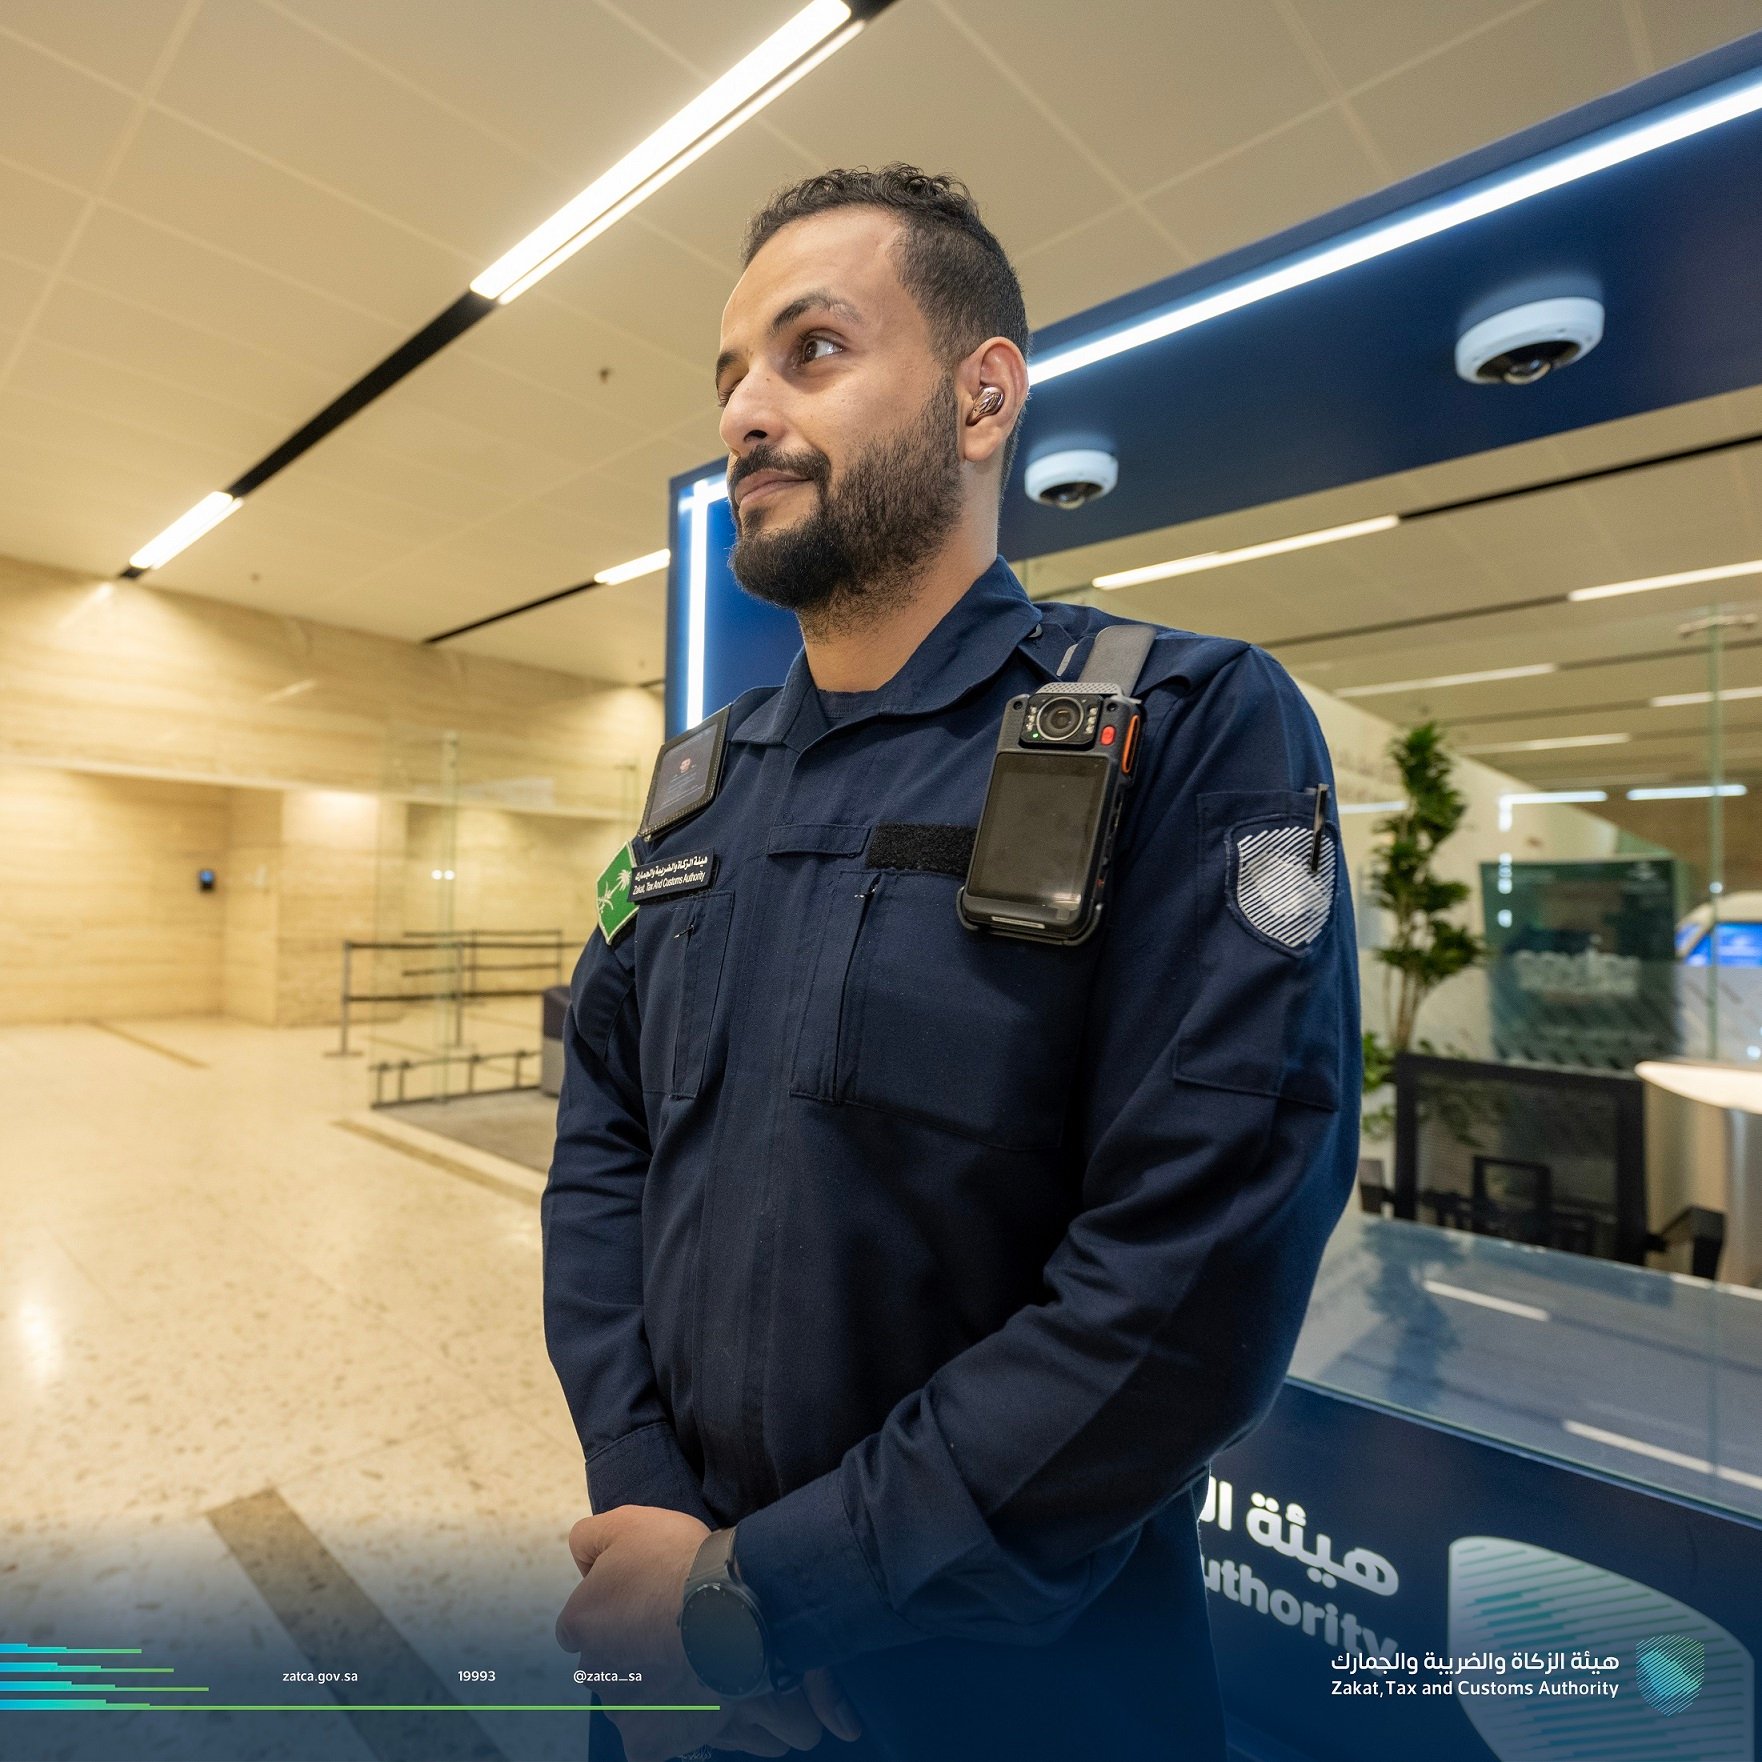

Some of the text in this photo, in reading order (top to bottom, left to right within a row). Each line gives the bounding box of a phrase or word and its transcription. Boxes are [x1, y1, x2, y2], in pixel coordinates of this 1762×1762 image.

[646, 881, 654, 892] Tax
[652, 878, 663, 889] And
[662, 876, 684, 888] Customs
[682, 870, 706, 883] Authority
[1246, 1492, 1399, 1596] هيئة
[1202, 1557, 1398, 1678] uthority
